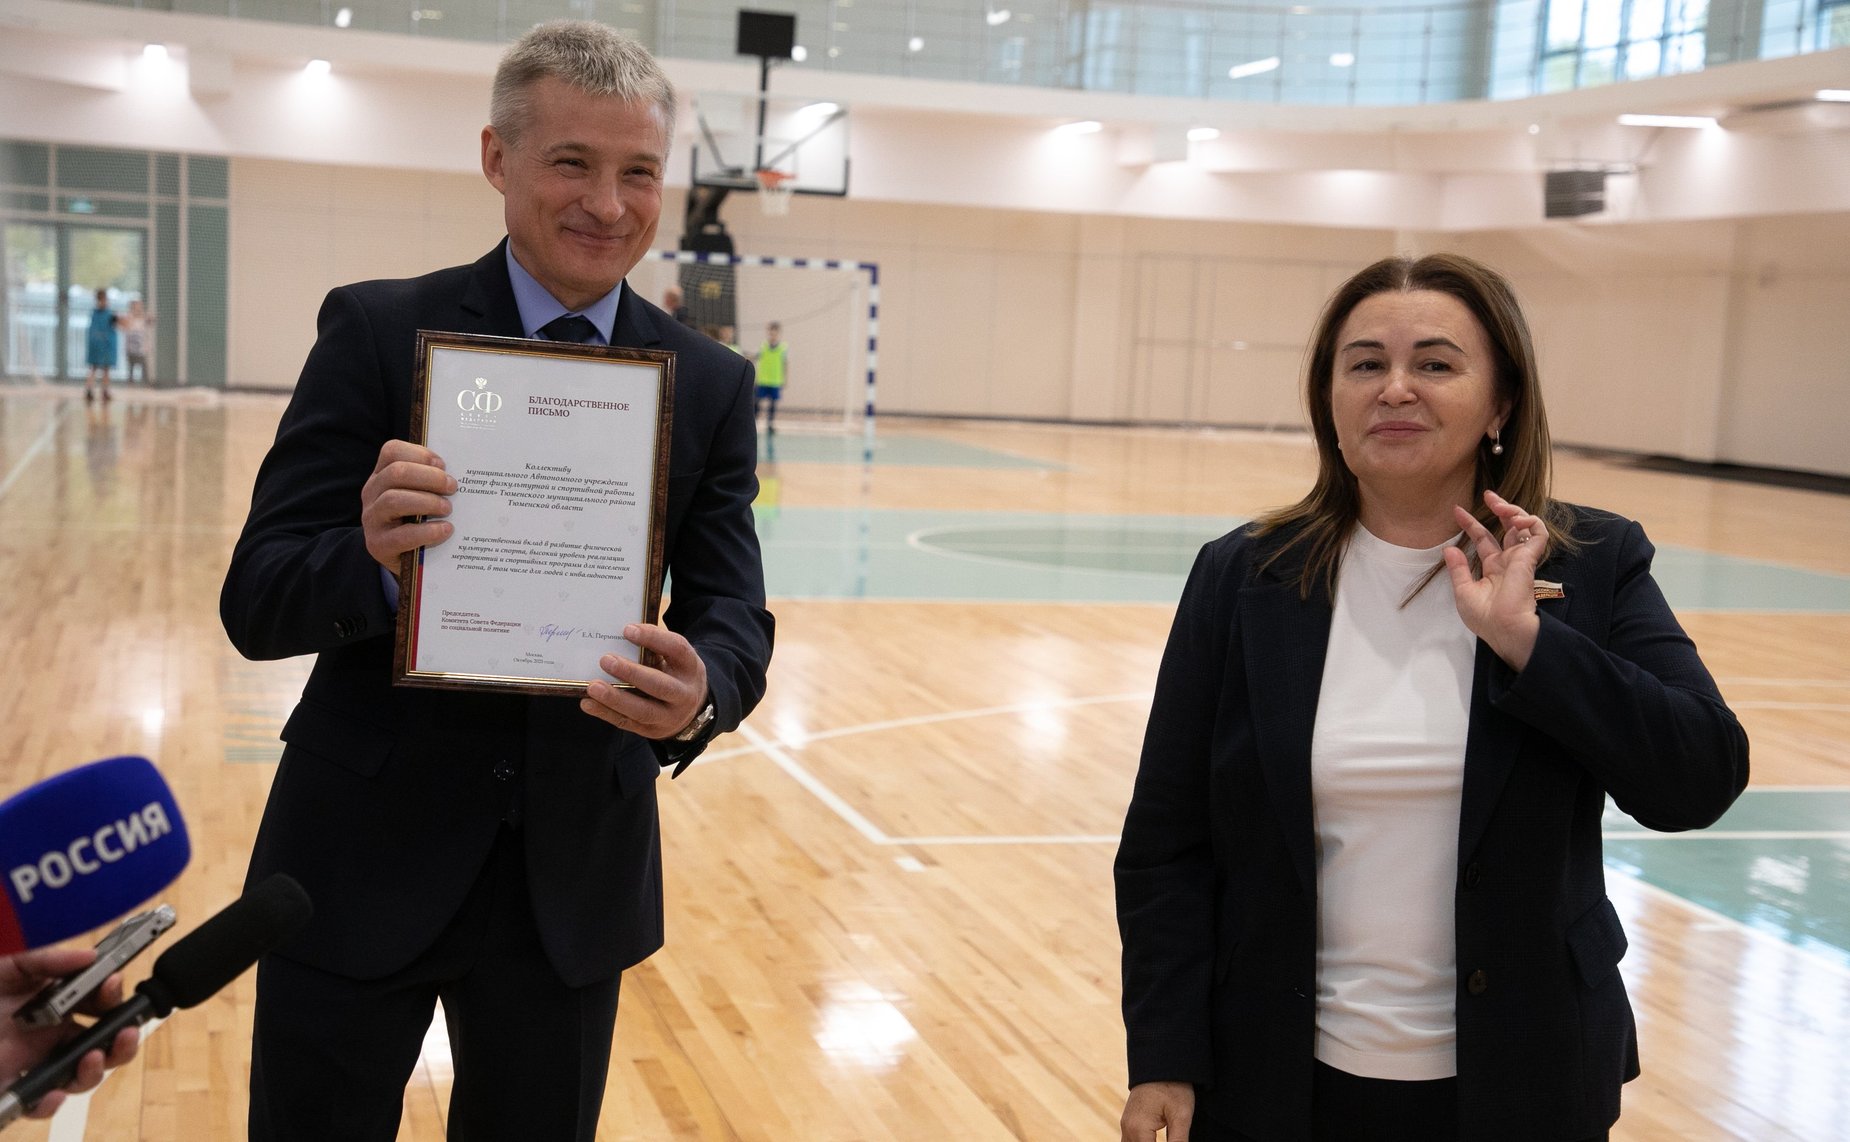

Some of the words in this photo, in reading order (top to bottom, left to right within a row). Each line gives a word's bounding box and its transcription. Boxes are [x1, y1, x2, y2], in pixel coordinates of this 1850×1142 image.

[528, 396, 630, 411] БЛАГОДАРСТВЕННОЕ
[528, 407, 570, 418] ПИСЬМО
[525, 463, 572, 474] Коллективу
[466, 469, 528, 480] муниципального
[530, 473, 582, 482] Автономного
[584, 478, 628, 487] учреждения
[458, 476, 488, 487] «Центр
[489, 480, 549, 490] физкультурной
[558, 485, 602, 494] спортивной
[604, 489, 635, 497] работы
[500, 489, 544, 499] Тюменского
[546, 494, 608, 504] муниципального
[608, 498, 636, 506] района
[508, 500, 550, 508] Тюменской
[551, 502, 584, 512] области
[471, 536, 522, 545] существенный
[523, 539, 543, 547] вклад
[550, 541, 582, 549] развитие
[583, 544, 622, 552] физической
[451, 554, 498, 562] мероприятий
[505, 558, 548, 566] спортивных
[548, 560, 582, 568] программ
[458, 545, 494, 554] культуры
[560, 552, 586, 560] уровень
[587, 554, 624, 562] реализации
[570, 571, 624, 580] инвалидностью
[442, 610, 480, 618] Председатель
[10, 801, 171, 904] РОССИЯ
